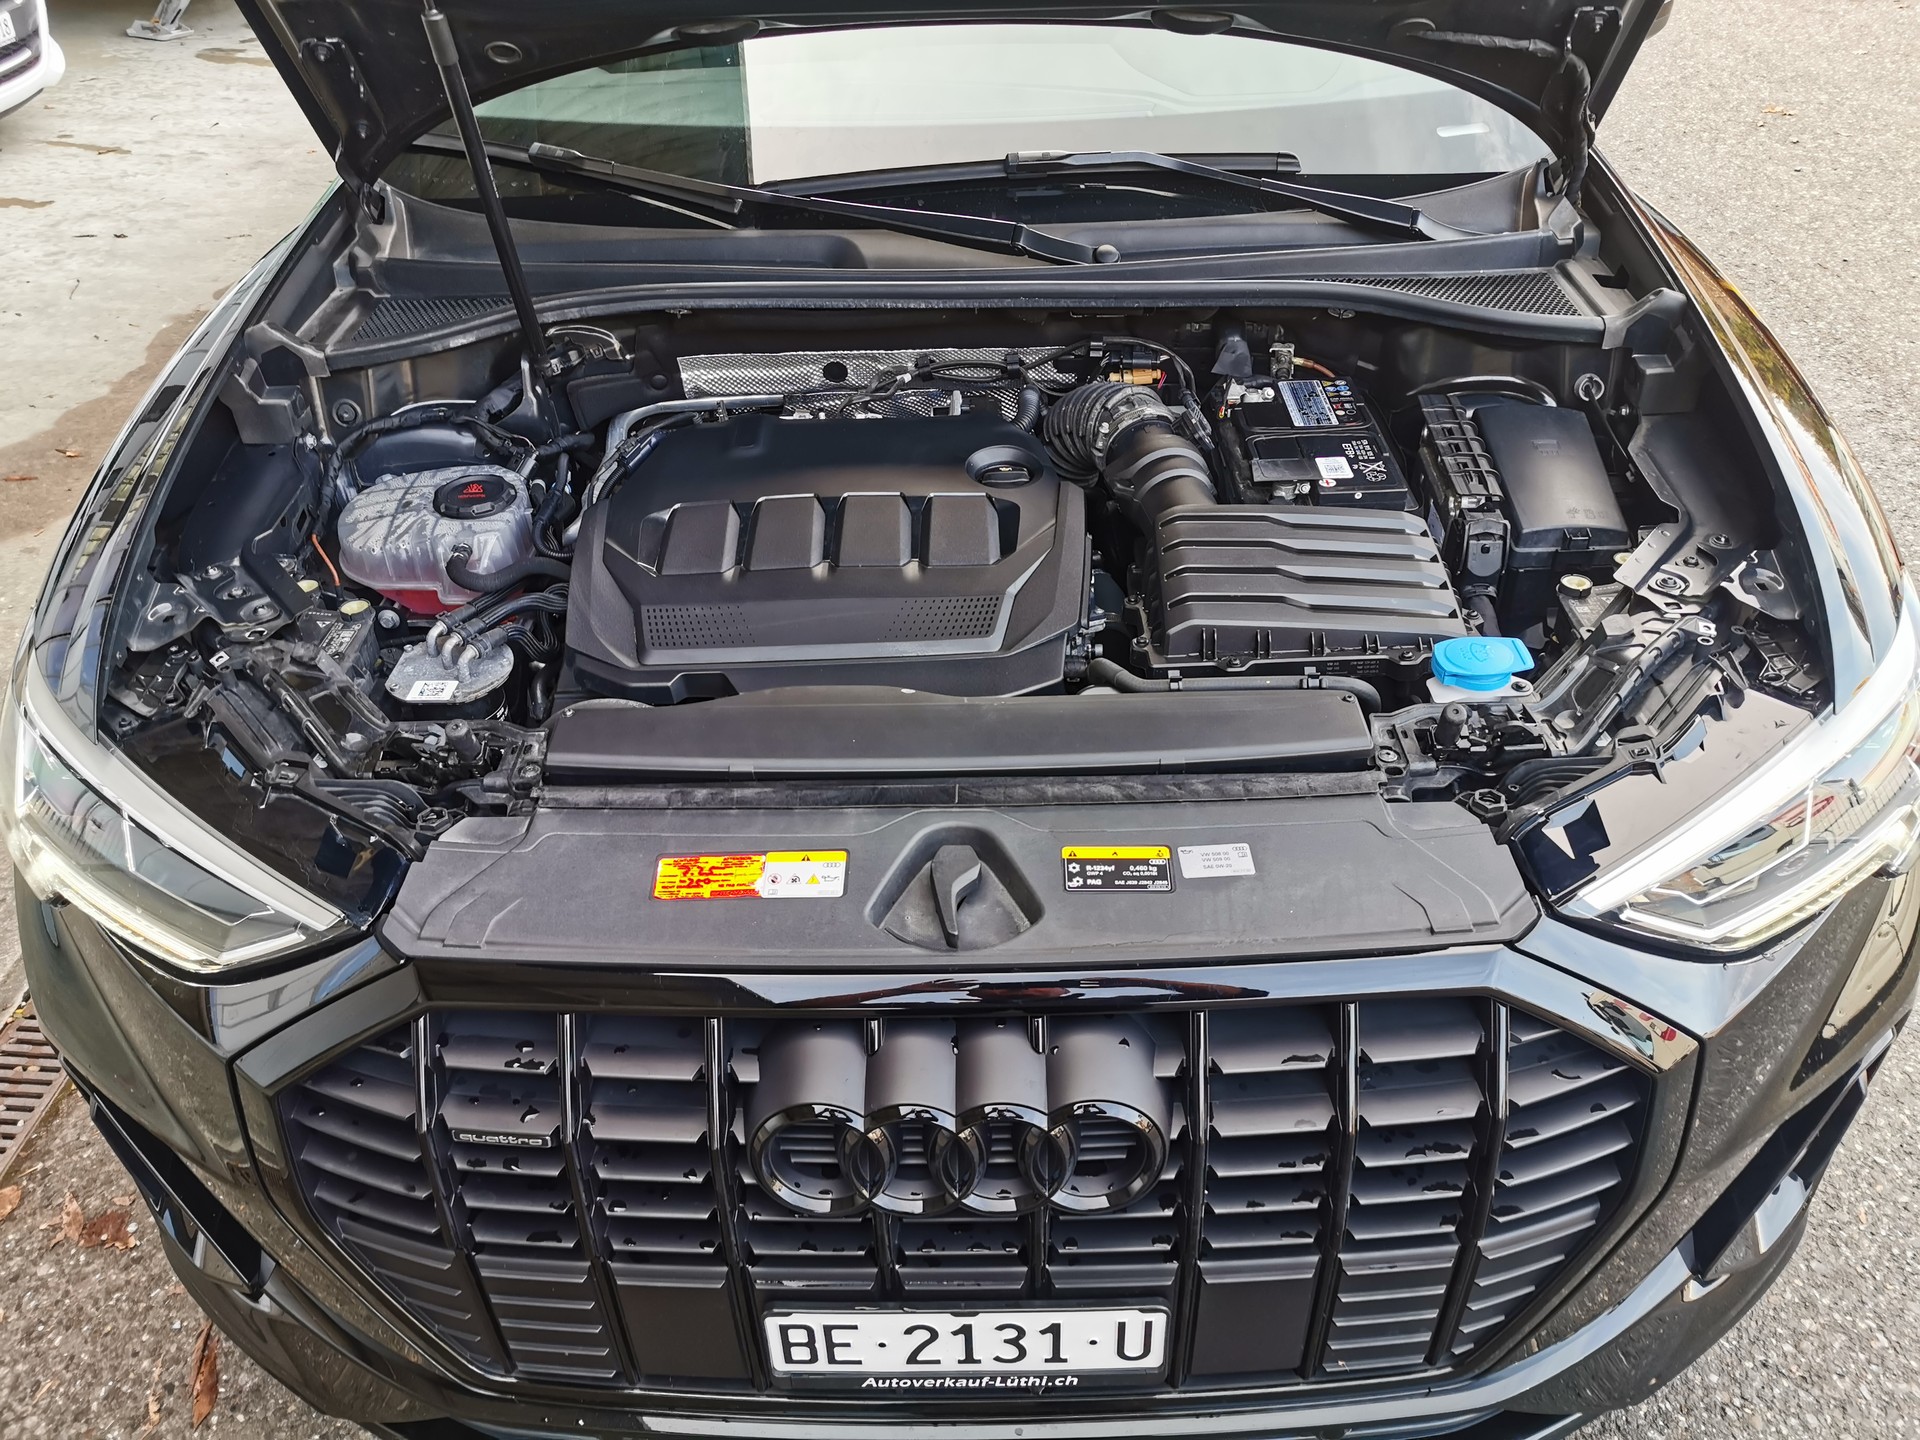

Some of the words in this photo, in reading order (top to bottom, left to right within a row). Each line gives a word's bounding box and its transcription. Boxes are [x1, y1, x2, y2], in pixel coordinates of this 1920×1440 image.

[1086, 865, 1115, 873] R-1234yf
[1149, 865, 1157, 873] kg
[459, 1133, 543, 1145] quattro
[778, 1323, 863, 1365] BE
[903, 1322, 1068, 1365] 2131
[1116, 1320, 1153, 1362] U
[861, 1376, 1079, 1388] Autoverkauf-Lüthi.ch
